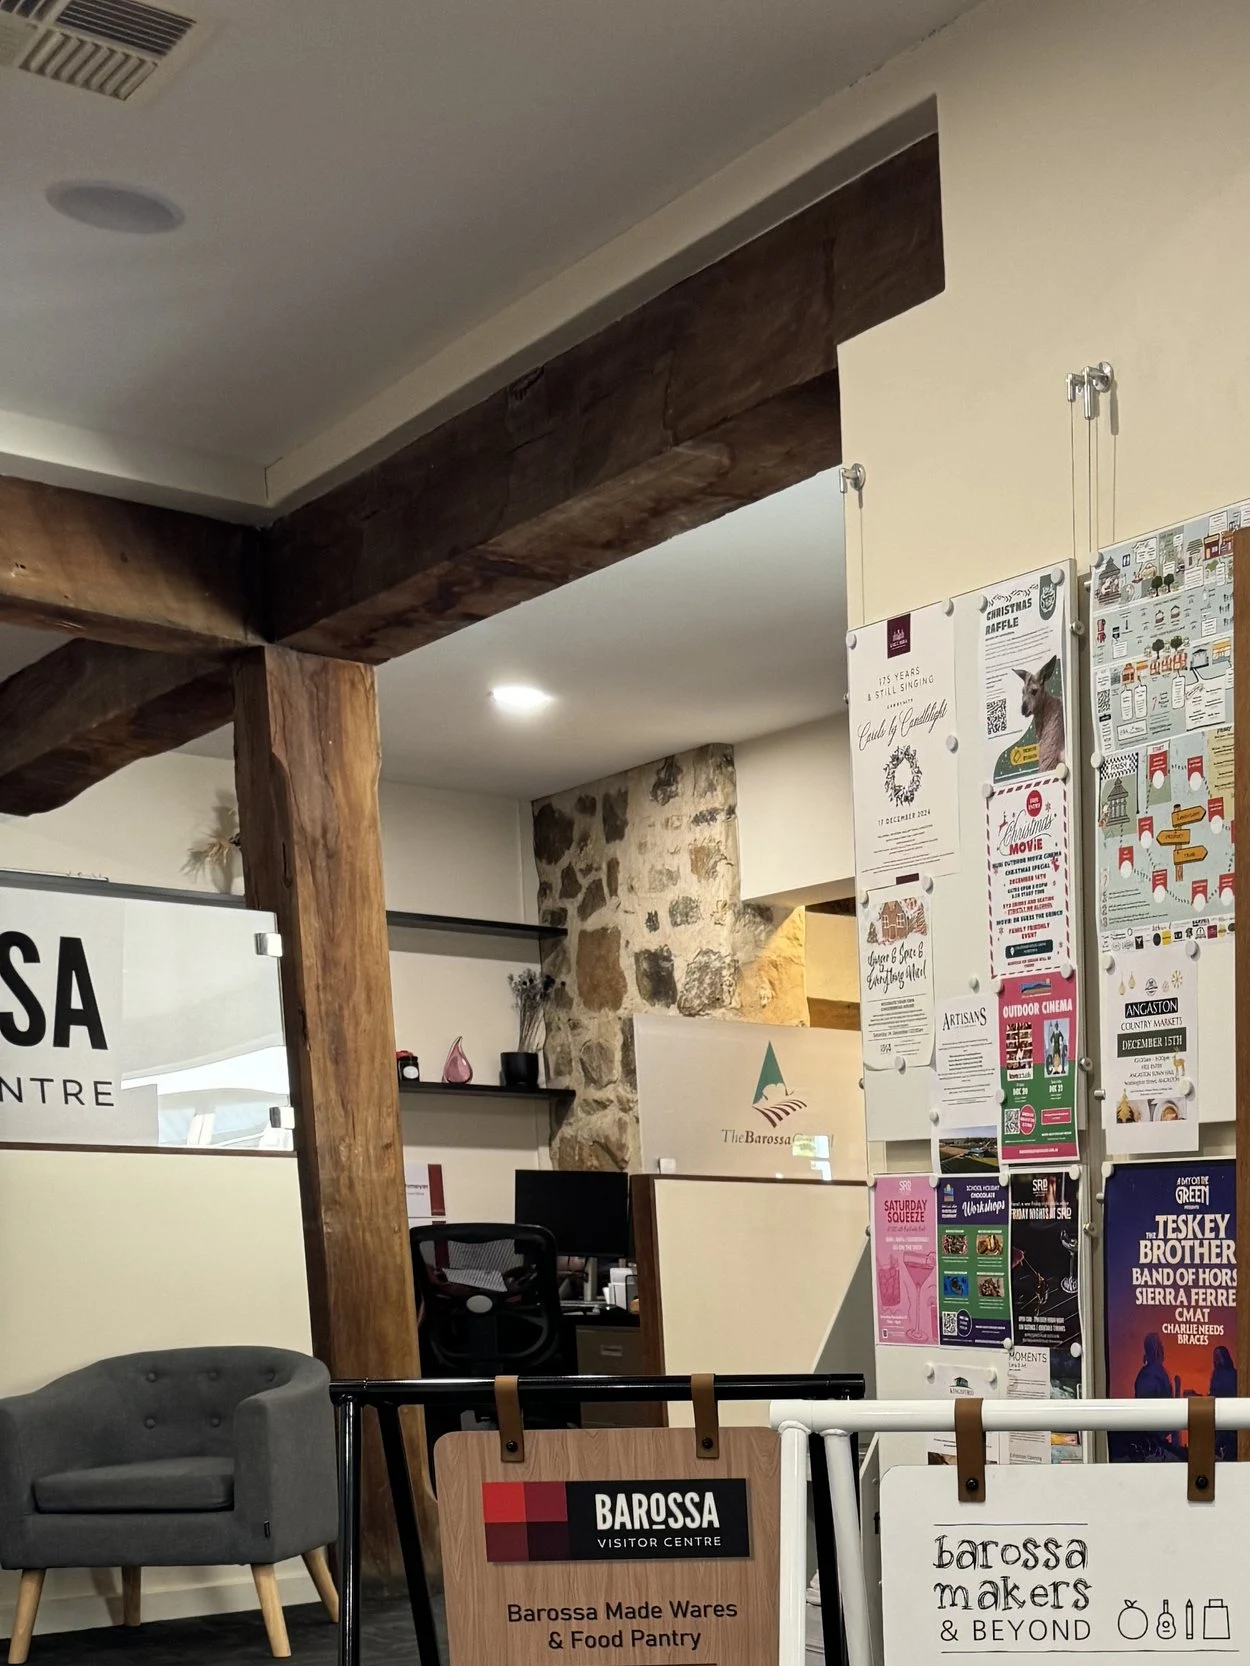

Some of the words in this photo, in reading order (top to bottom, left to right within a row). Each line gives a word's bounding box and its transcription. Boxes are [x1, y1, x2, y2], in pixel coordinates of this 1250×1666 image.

[986, 597, 1032, 621] CHRISTMAS
[985, 616, 1019, 636] RAFFLE
[894, 666, 920, 681] YEARS
[875, 685, 897, 700] STILL
[900, 674, 934, 692] SINGING
[1000, 809, 1053, 848] Christmas
[0, 931, 108, 1050] SA
[1002, 1003, 1039, 1018] OUTDOOR
[1041, 998, 1073, 1014] CINEMA
[1125, 999, 1178, 1017] ANGASTON
[942, 1007, 987, 1031] ARTISANS
[1120, 1020, 1152, 1031] COUNTRY
[1153, 1016, 1182, 1028] MARKETS
[1122, 1037, 1163, 1050] DECEMBER
[1164, 1034, 1183, 1047] 15TH
[1175, 1185, 1210, 1206] GREEN
[884, 1200, 927, 1212] SATURDAY
[961, 1199, 1005, 1217] Workshops
[887, 1211, 925, 1224] SQUEEZE
[1155, 1213, 1231, 1240] TESKEY
[1139, 1239, 1237, 1265] BROTHER
[1132, 1267, 1174, 1286] BAND
[1175, 1267, 1197, 1287] OF
[1135, 1287, 1188, 1306] SIERRA
[1190, 1288, 1237, 1307] FERRE
[1174, 1307, 1210, 1323] CMAT
[1161, 1323, 1198, 1335] CHARLIE
[1198, 1324, 1224, 1336] NEEDS
[1177, 1334, 1209, 1345] BRACES
[1008, 1350, 1048, 1363] MOMENTS
[594, 1491, 721, 1531] BAROSSA
[597, 1537, 658, 1548] VISITOR
[664, 1536, 722, 1548] CENTRE
[933, 1534, 1089, 1571] barossa
[933, 1575, 1093, 1612] makers
[507, 1603, 598, 1623] Barossa
[605, 1601, 663, 1620] Made
[668, 1600, 739, 1619] Wares
[548, 1631, 563, 1650] &
[570, 1630, 624, 1649] Food
[630, 1629, 702, 1651] Pantry
[939, 1619, 959, 1642] &
[972, 1618, 1091, 1642] BEYOND
